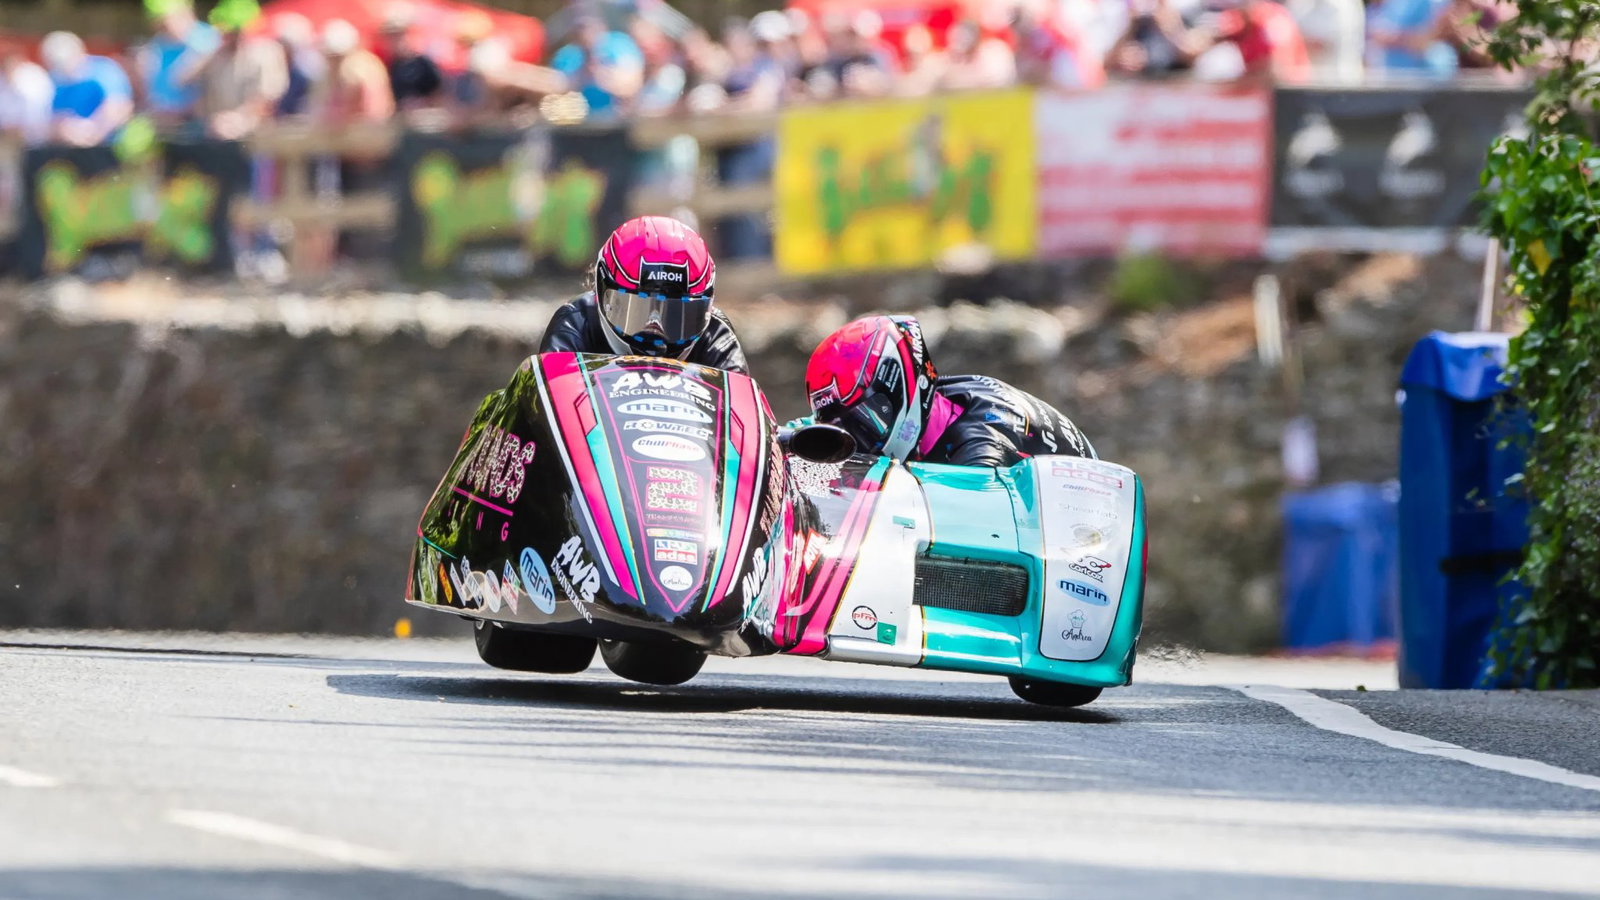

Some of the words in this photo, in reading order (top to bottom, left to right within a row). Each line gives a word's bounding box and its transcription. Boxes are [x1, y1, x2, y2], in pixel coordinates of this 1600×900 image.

[648, 271, 683, 282] AIROH
[907, 321, 923, 365] AIROH
[609, 389, 716, 412] ENGINEERING
[612, 372, 712, 401] AWB
[626, 403, 705, 419] marin
[646, 465, 703, 514] 2
[521, 551, 554, 606] marin
[556, 535, 601, 604] AWB
[550, 557, 593, 625] ENGINEERING
[1060, 580, 1107, 603] marin
